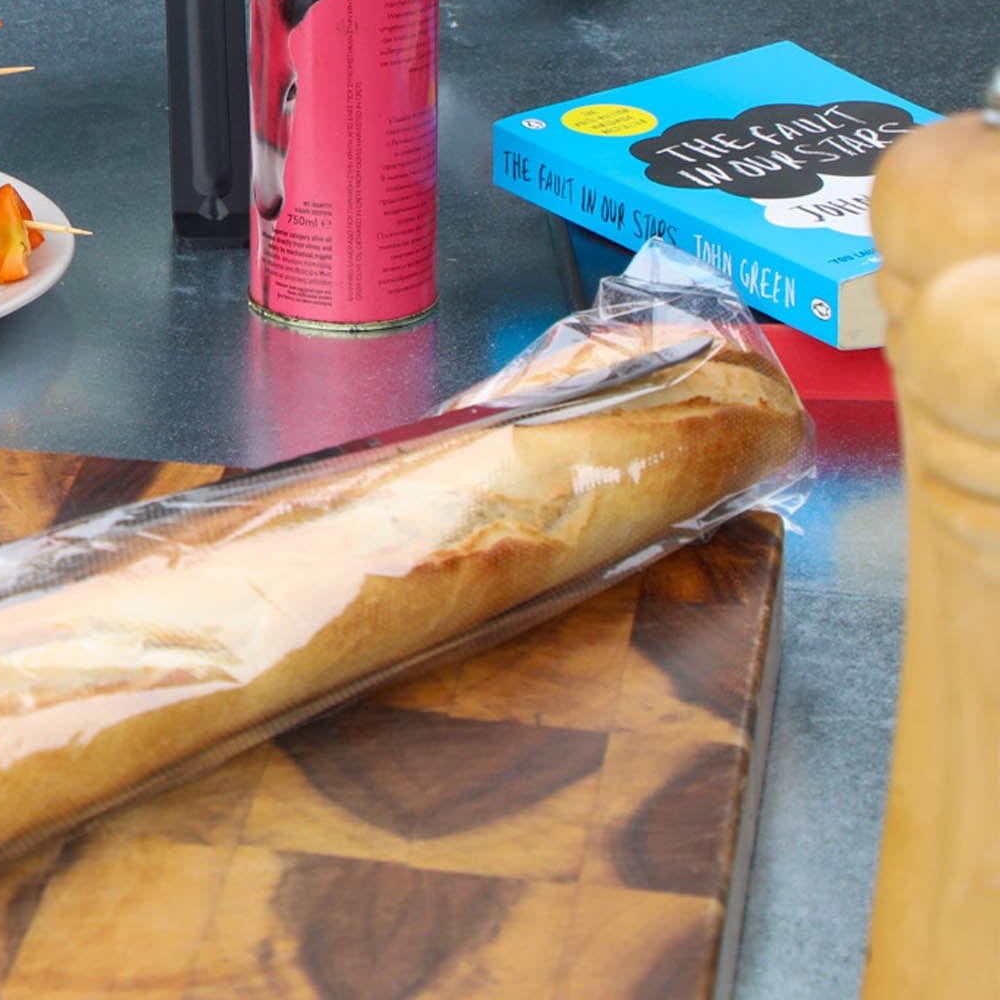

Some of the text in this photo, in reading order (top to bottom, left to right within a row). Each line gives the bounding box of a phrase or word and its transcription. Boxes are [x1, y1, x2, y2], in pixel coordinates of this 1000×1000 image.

[656, 105, 867, 162] THE FAULT
[676, 163, 734, 188] IN
[728, 149, 808, 178] OUR
[504, 151, 531, 181] THE
[539, 163, 575, 204] FAULT
[581, 186, 597, 215] IN
[601, 196, 626, 231] OUR
[692, 234, 732, 277] JOHN
[740, 259, 796, 308] GREEN
